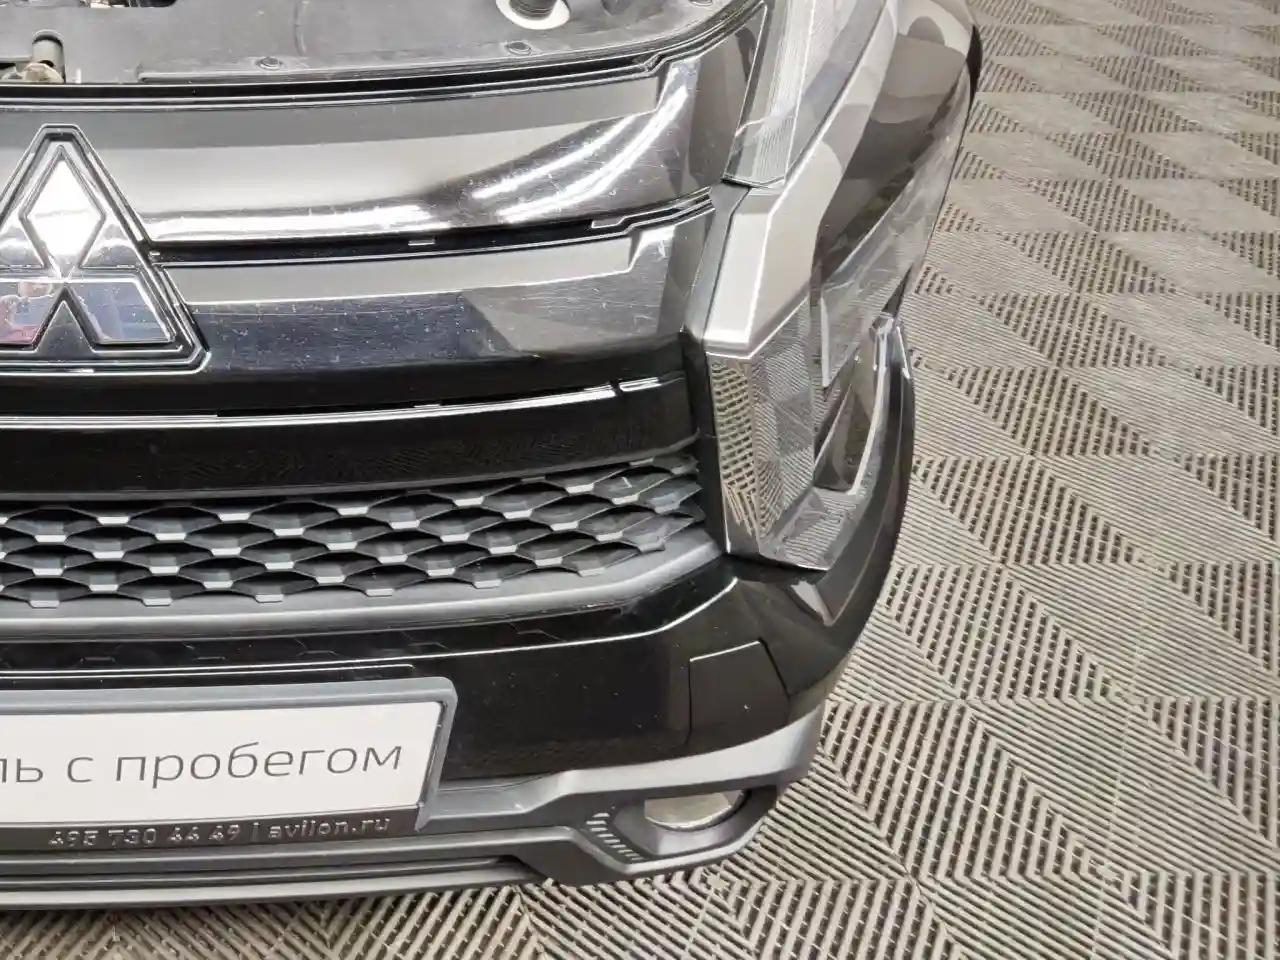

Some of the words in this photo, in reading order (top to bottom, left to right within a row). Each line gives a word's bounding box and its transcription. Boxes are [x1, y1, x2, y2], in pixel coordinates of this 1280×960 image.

[66, 756, 94, 783] с
[115, 741, 402, 789] пробегом
[269, 818, 391, 839] avilon.ru
